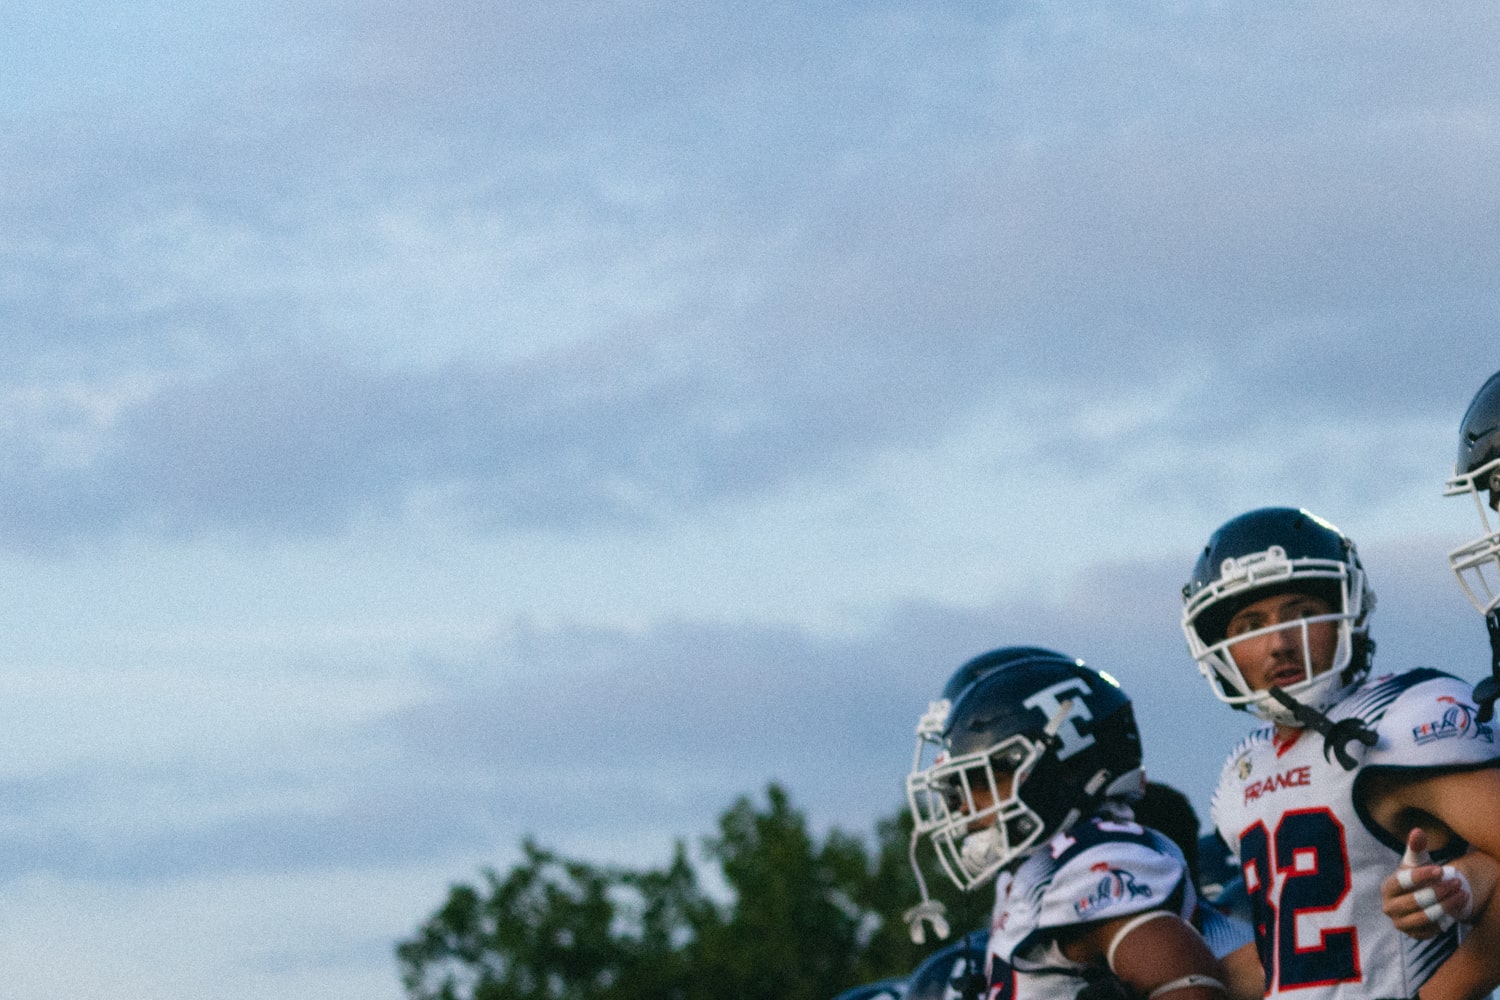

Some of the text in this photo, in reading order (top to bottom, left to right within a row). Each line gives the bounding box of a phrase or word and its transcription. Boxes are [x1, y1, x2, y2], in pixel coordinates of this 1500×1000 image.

[1023, 677, 1096, 762] F
[1244, 764, 1312, 807] FRANCE
[1239, 806, 1362, 998] 82
